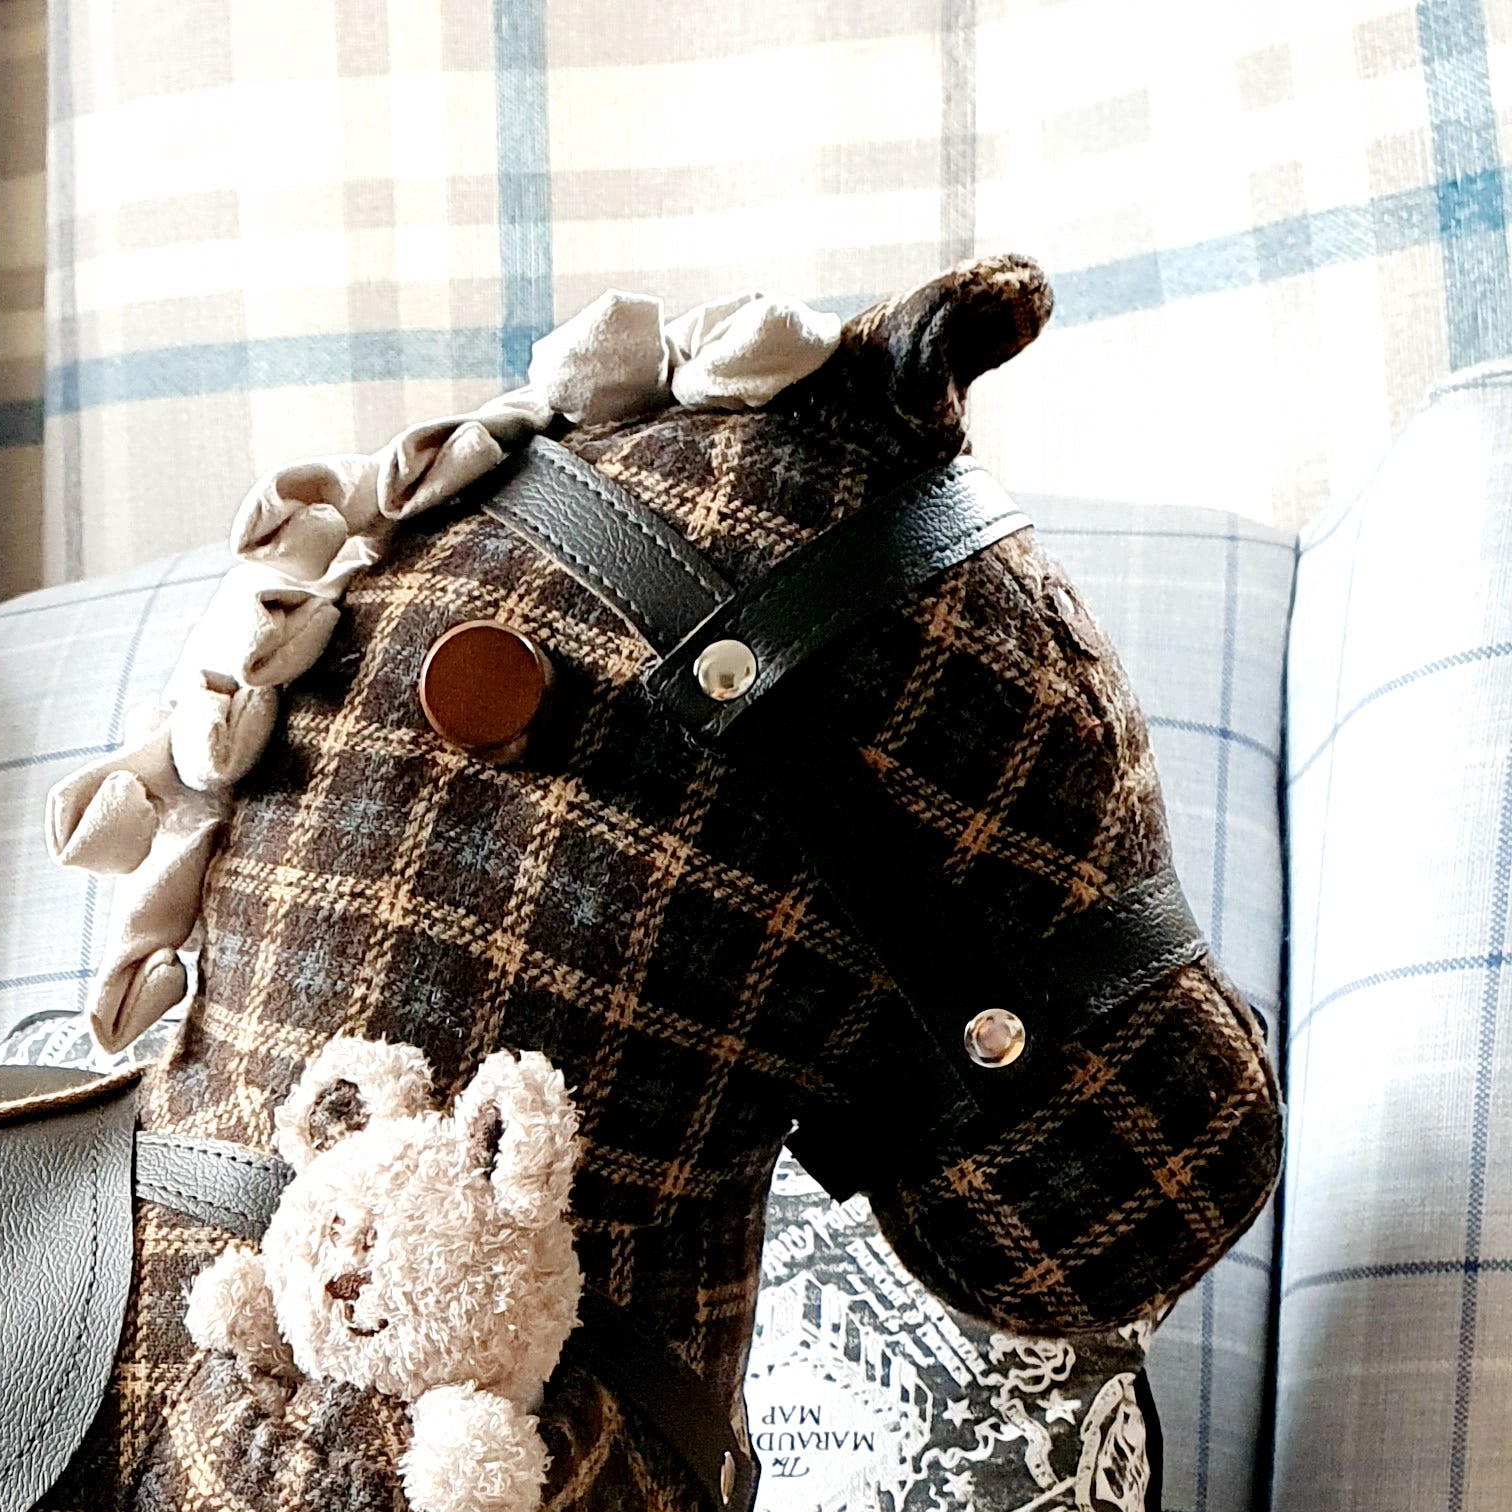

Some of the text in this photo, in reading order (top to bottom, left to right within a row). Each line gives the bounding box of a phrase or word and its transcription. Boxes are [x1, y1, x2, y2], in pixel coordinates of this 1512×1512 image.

[761, 1405, 821, 1425] MAP
[749, 1431, 875, 1452] MARAUD
[771, 1456, 810, 1478] The
